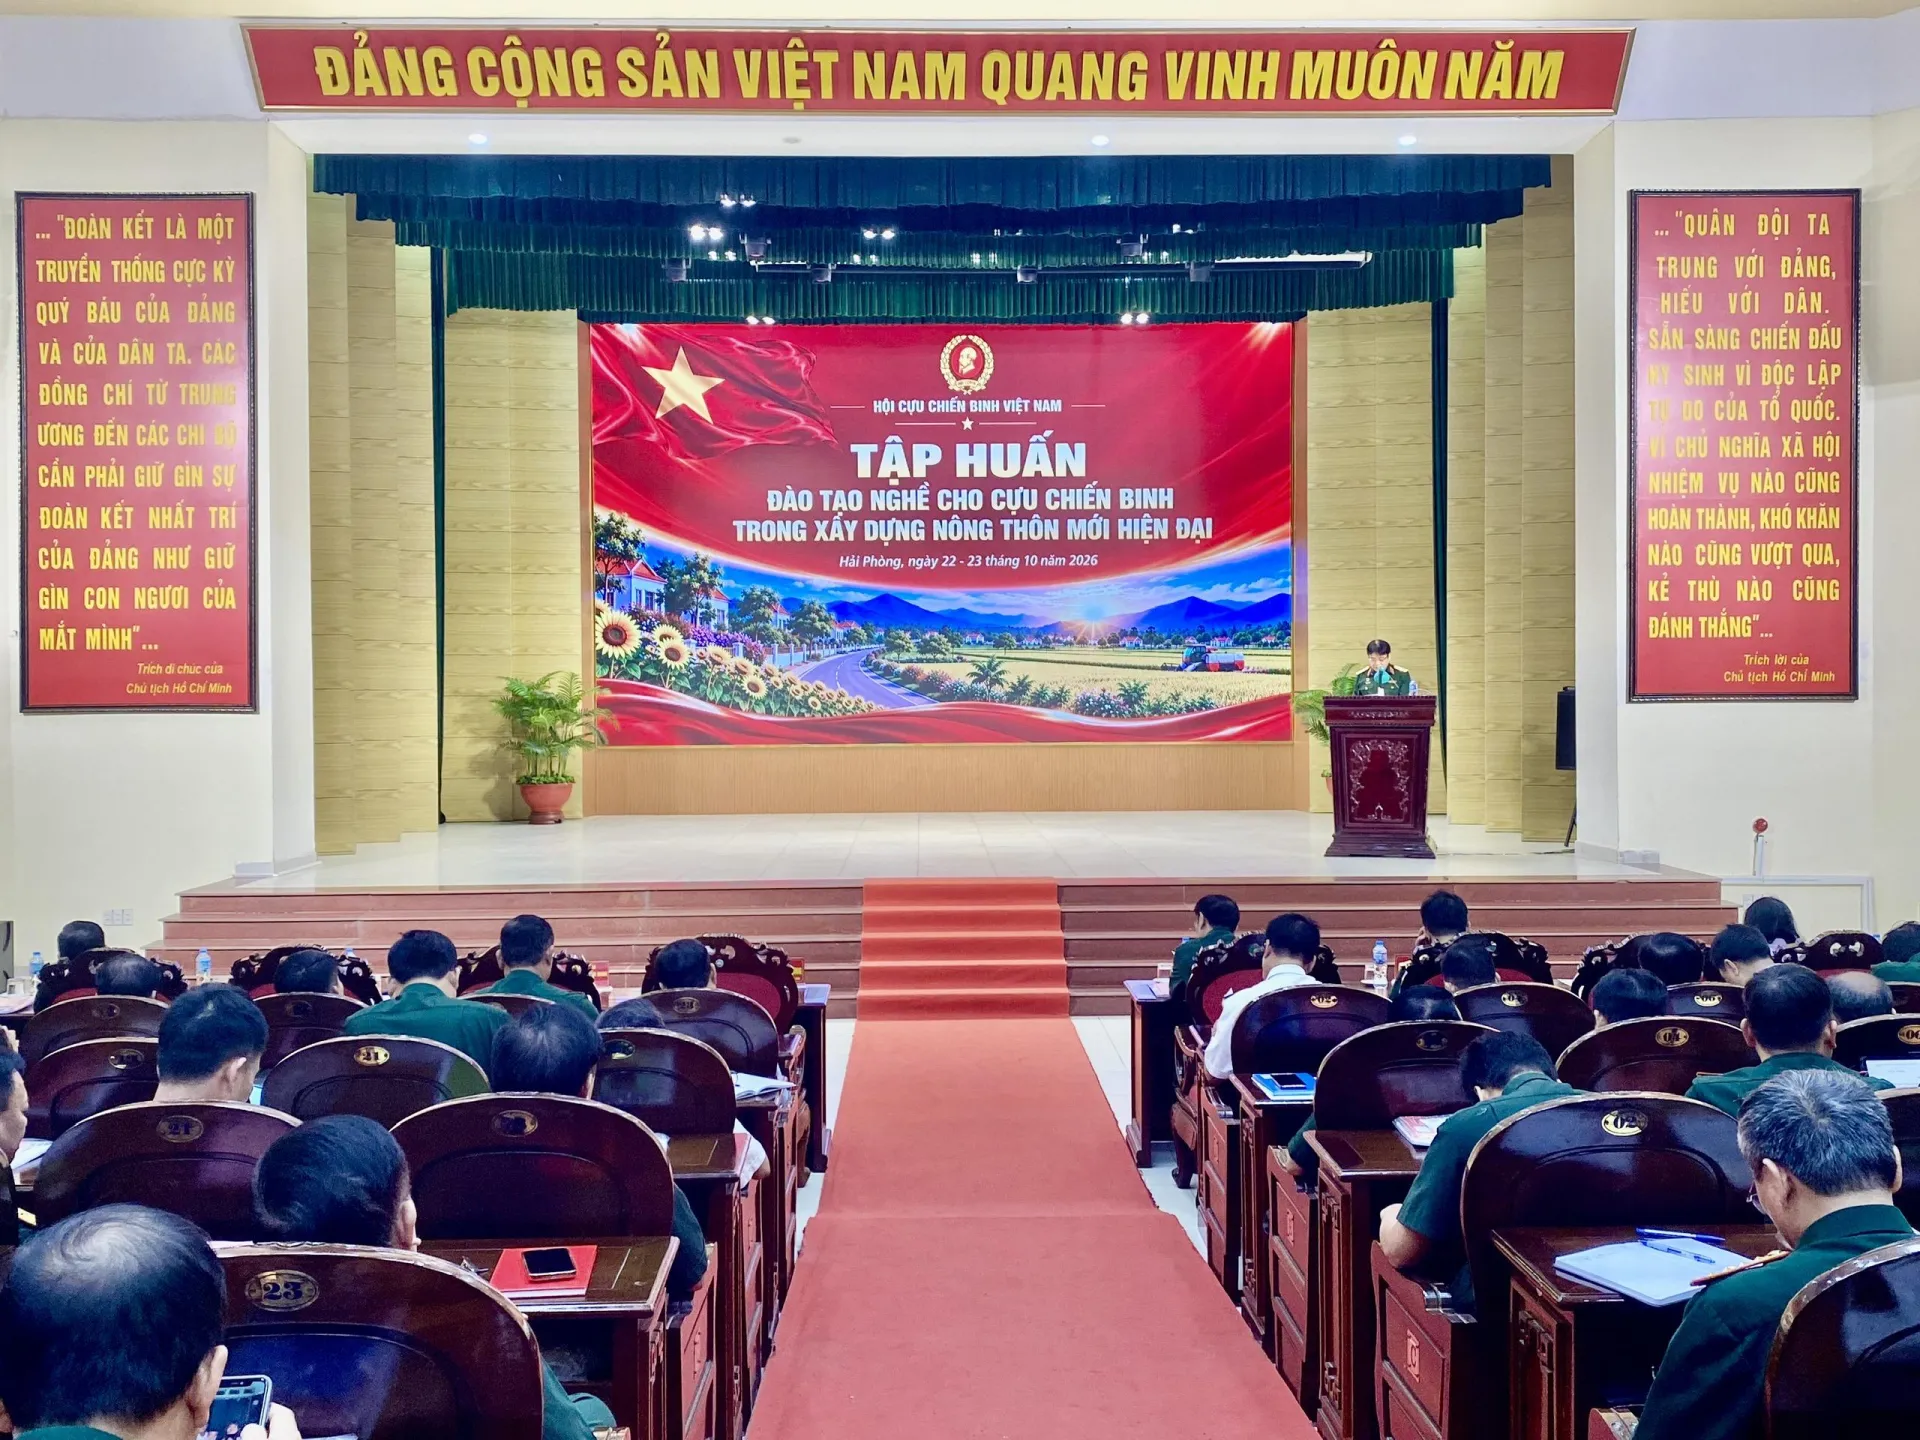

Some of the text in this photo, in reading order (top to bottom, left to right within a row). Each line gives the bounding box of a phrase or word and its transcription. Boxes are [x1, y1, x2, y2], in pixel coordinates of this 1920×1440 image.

[313, 29, 1565, 110] ĐẢNG CỘNG SẢN VIỆT NAM QUANG VINH MUÔN NĂM
[123, 209, 154, 239] KẾT
[166, 213, 186, 239] LÀ
[198, 213, 234, 244] MỘT
[1758, 208, 1789, 240] ĐỘI
[1808, 214, 1830, 235] TA
[36, 252, 235, 287] TRUYỀN THỐNG CỰC KỲ
[1656, 248, 1835, 280] TRUNG VỚI ĐẢNG,
[36, 293, 235, 326] QUÝ BÁU CỦA ĐẢNG
[1661, 285, 1829, 314] HIẾU VỚI DÂN.
[39, 335, 235, 365] VÀ CỦA DÂN TA. CÁC
[1649, 320, 1841, 350] SẴN SÀNG CHIẾN ĐẤU
[1684, 364, 1724, 385] SINH
[1736, 360, 1750, 385] VÌ
[1762, 359, 1795, 389] ĐỘC
[1808, 359, 1841, 389] LẬP
[39, 376, 236, 406] ĐỒNG CHÍ TỪ TRUNG
[874, 396, 1061, 415] HỘI CỰU CHIẾN BINH VIỆT NAM
[1682, 400, 1703, 421] DO
[1714, 392, 1748, 421] CỦA
[1760, 390, 1780, 421] TỔ
[1791, 392, 1840, 423] QUỐC.
[38, 422, 84, 446] ƯƠNG
[94, 417, 128, 446] ĐẾN
[136, 420, 169, 446] CÁC
[177, 424, 204, 445] CHI
[1675, 429, 1708, 458] CHỦ
[1719, 432, 1771, 458] NGHĨA
[1782, 431, 1804, 458] XÃ
[1813, 431, 1840, 461] HỘI
[850, 430, 1086, 485] TẬP HUẤN
[39, 458, 236, 492] CẦN PHẢI GIỮ GÌN SỰ
[1649, 468, 1840, 498] NHIỆM VỤ NÀO CŨNG
[767, 481, 1174, 516] ĐÀO TẠO NGHỀ CHO CỰU CHIẾN BINH
[39, 499, 236, 529] ĐOÀN KẾT NHẤT TRÍ
[1648, 502, 1840, 532] HOÀN THÀNH, KHÓ KHĂN
[733, 520, 807, 542] TRONG
[864, 518, 925, 546] DỰNG
[932, 515, 993, 541] NÔNG
[1000, 514, 1059, 541] THÔN
[1067, 514, 1110, 540] MỚI
[1118, 513, 1168, 544] HIỆN
[1176, 518, 1212, 544] ĐẠI
[38, 539, 235, 569] CỦA ĐẢNG NHƯ GIỮ
[839, 555, 859, 568] Hải
[863, 555, 904, 570] Phòng,
[908, 555, 938, 570] ngày
[941, 556, 956, 566] 22
[967, 555, 982, 567] 23
[985, 554, 1020, 569] tháng
[1024, 555, 1038, 566] 10
[1041, 554, 1065, 566] năm
[1069, 555, 1098, 566] 2026
[1648, 540, 1840, 569] NÀO CŨNG VƯỢT QUA,
[39, 583, 69, 609] GÌN
[84, 587, 119, 609] CON
[203, 579, 236, 609] CỦA
[1649, 572, 1840, 601] KẺ THÙ NÀO CŨNG
[39, 621, 76, 650] MẮT
[1649, 612, 1692, 638] ĐÁNH
[137, 662, 162, 674] Trích
[177, 663, 201, 674] chúc
[205, 661, 223, 674] của
[1744, 651, 1809, 665] Trích lời của
[150, 683, 169, 696] tịch
[189, 681, 207, 693] Chí
[208, 683, 232, 693] Minh
[1748, 672, 1767, 684] tịch
[1790, 670, 1808, 681] Chí
[1811, 671, 1835, 681] Minh
